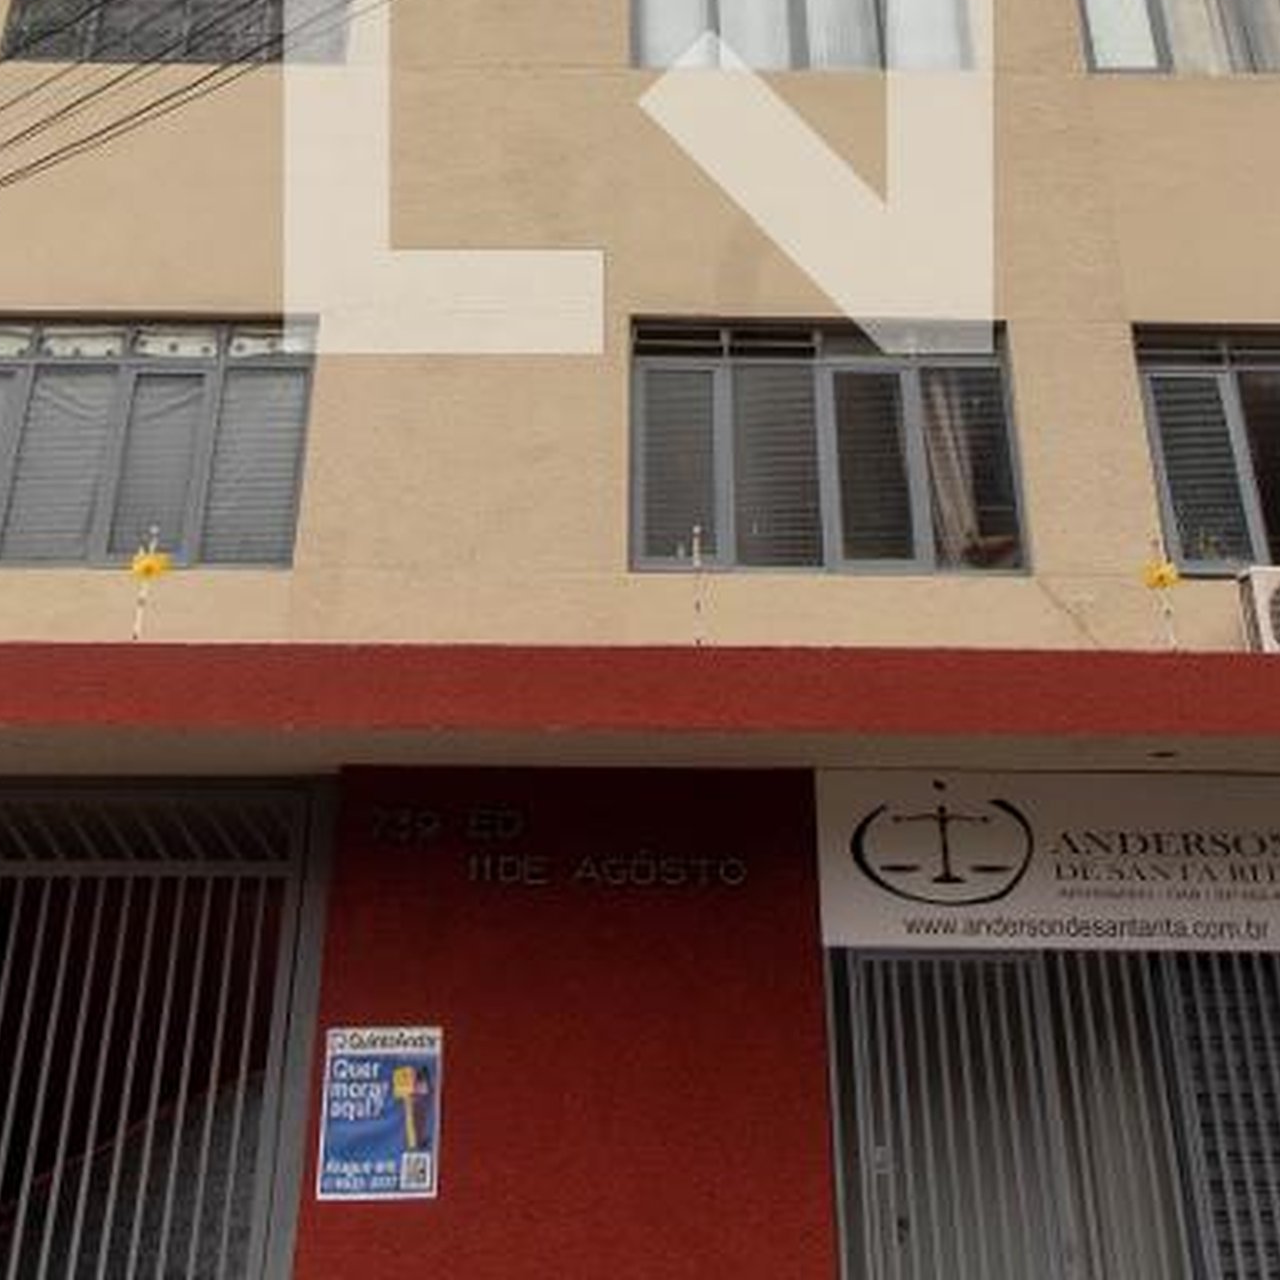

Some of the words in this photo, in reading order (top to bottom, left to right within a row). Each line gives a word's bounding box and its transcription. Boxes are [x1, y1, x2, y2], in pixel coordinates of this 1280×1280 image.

[571, 851, 749, 886] AGOSTO
[1107, 863, 1218, 883] SANTA
[333, 1059, 382, 1079] Quer
